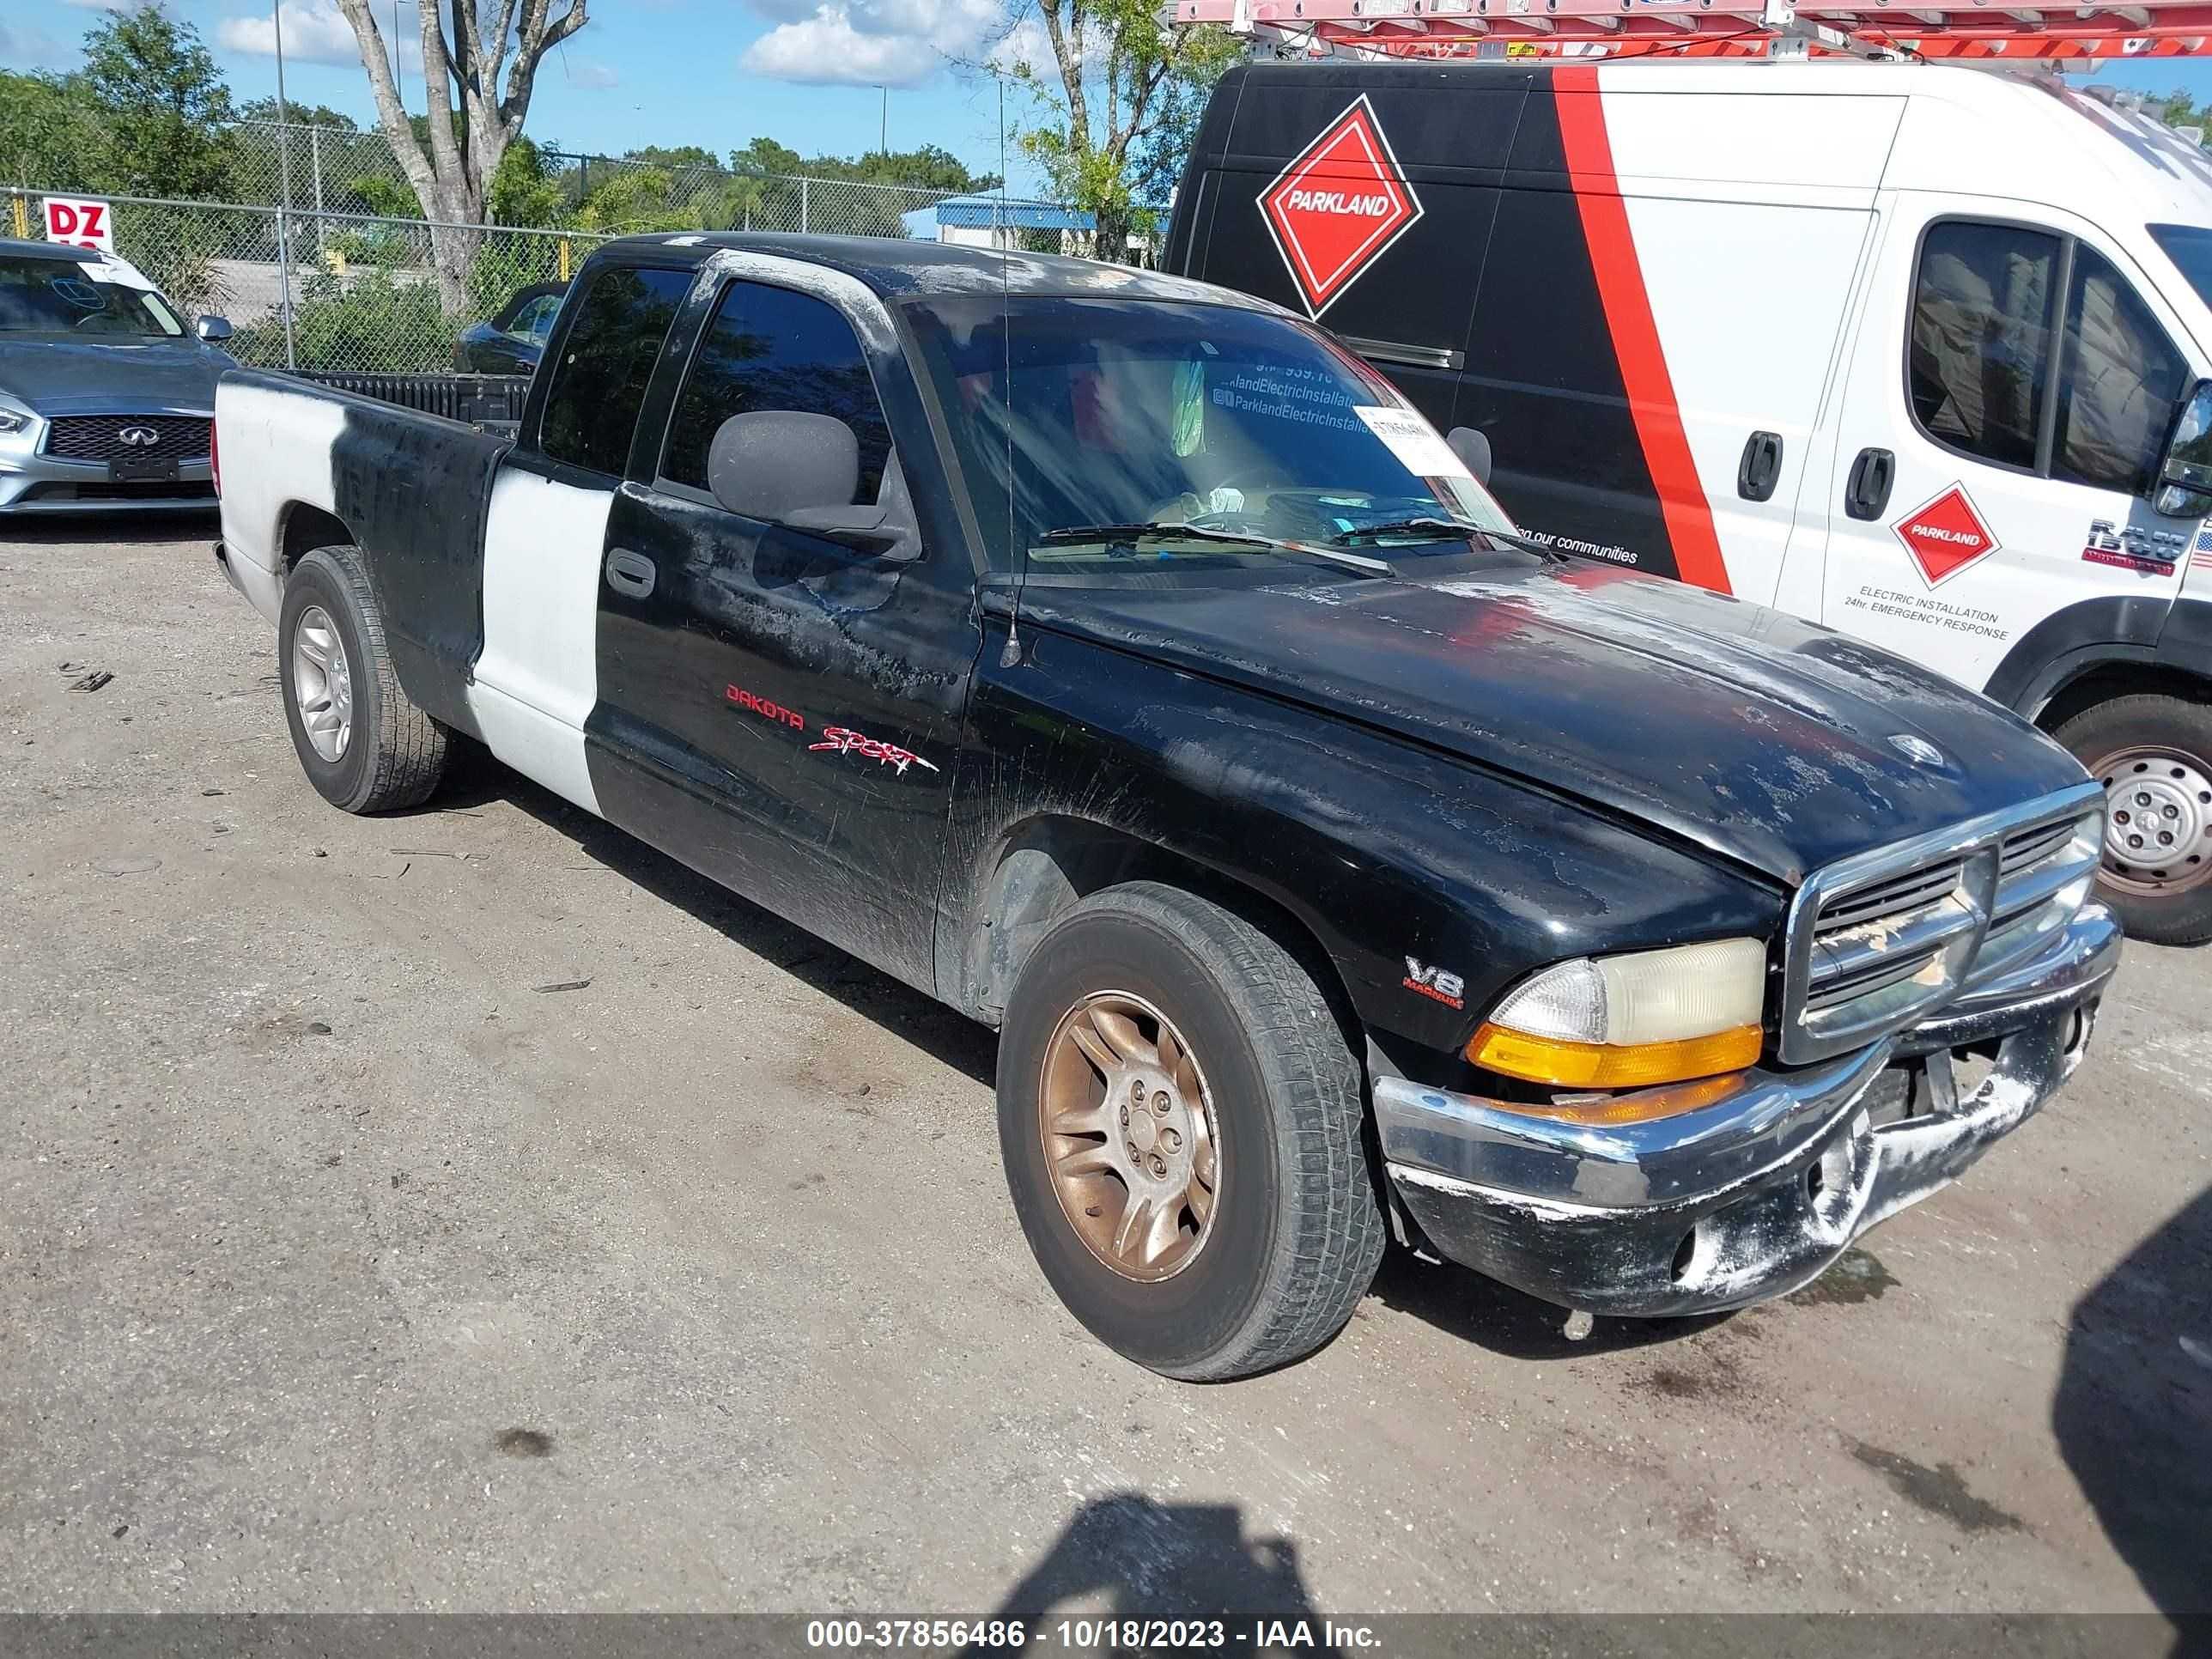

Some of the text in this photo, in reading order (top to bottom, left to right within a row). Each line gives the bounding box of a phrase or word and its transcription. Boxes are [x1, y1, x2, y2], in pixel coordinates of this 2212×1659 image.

[48, 203, 104, 238] DZ
[1288, 190, 1389, 216] PARKLAND
[1534, 532, 1556, 545] our
[1557, 537, 1638, 564] communities
[1911, 525, 1979, 546] PARKLAND
[1844, 597, 2009, 641] 24hr. EMERGENCY RESPONSE
[1860, 586, 1999, 623] ELECTRIC INSTALLATION
[726, 684, 939, 775] DAKOTA SPORT
[1405, 955, 1464, 998] V8
